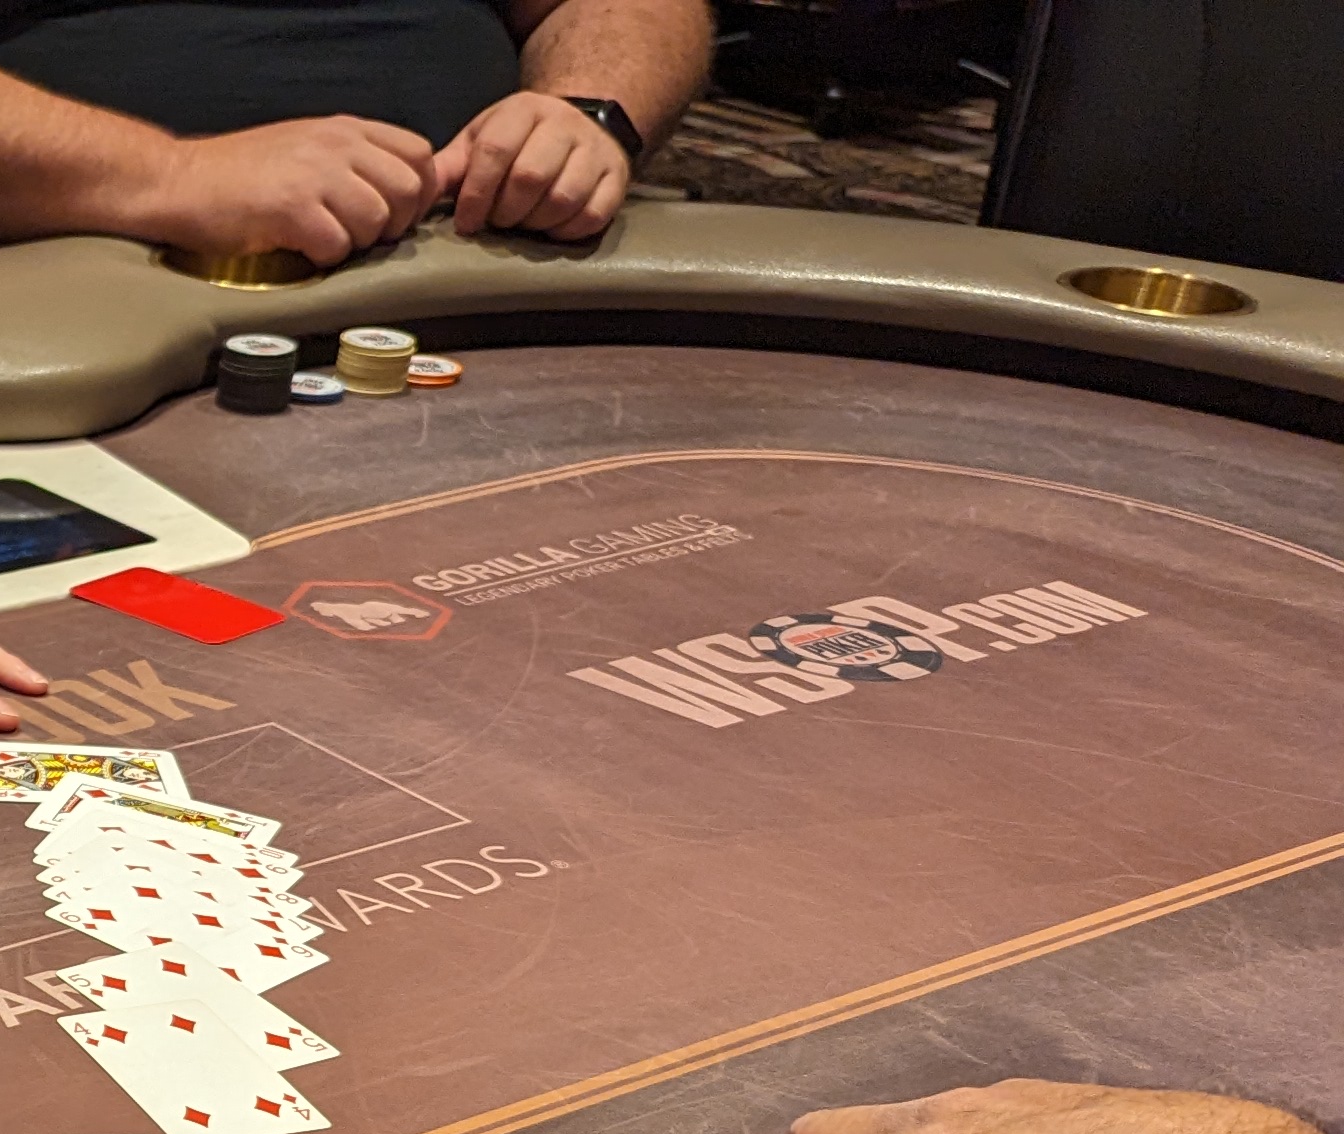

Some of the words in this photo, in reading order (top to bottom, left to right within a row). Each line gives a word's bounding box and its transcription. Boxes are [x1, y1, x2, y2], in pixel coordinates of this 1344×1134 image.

[412, 546, 580, 592] GORILLA
[569, 513, 719, 554] GAMING
[455, 574, 562, 606] LEGENDARY
[259, 849, 285, 859] 10
[265, 863, 288, 876] 9
[275, 893, 299, 905] 8
[59, 911, 81, 923] 6
[295, 919, 311, 931] 7
[290, 945, 313, 958] 6
[68, 974, 91, 987] 5
[74, 1022, 92, 1035] 4
[302, 1037, 328, 1053] 5
[293, 1106, 311, 1121] 4
